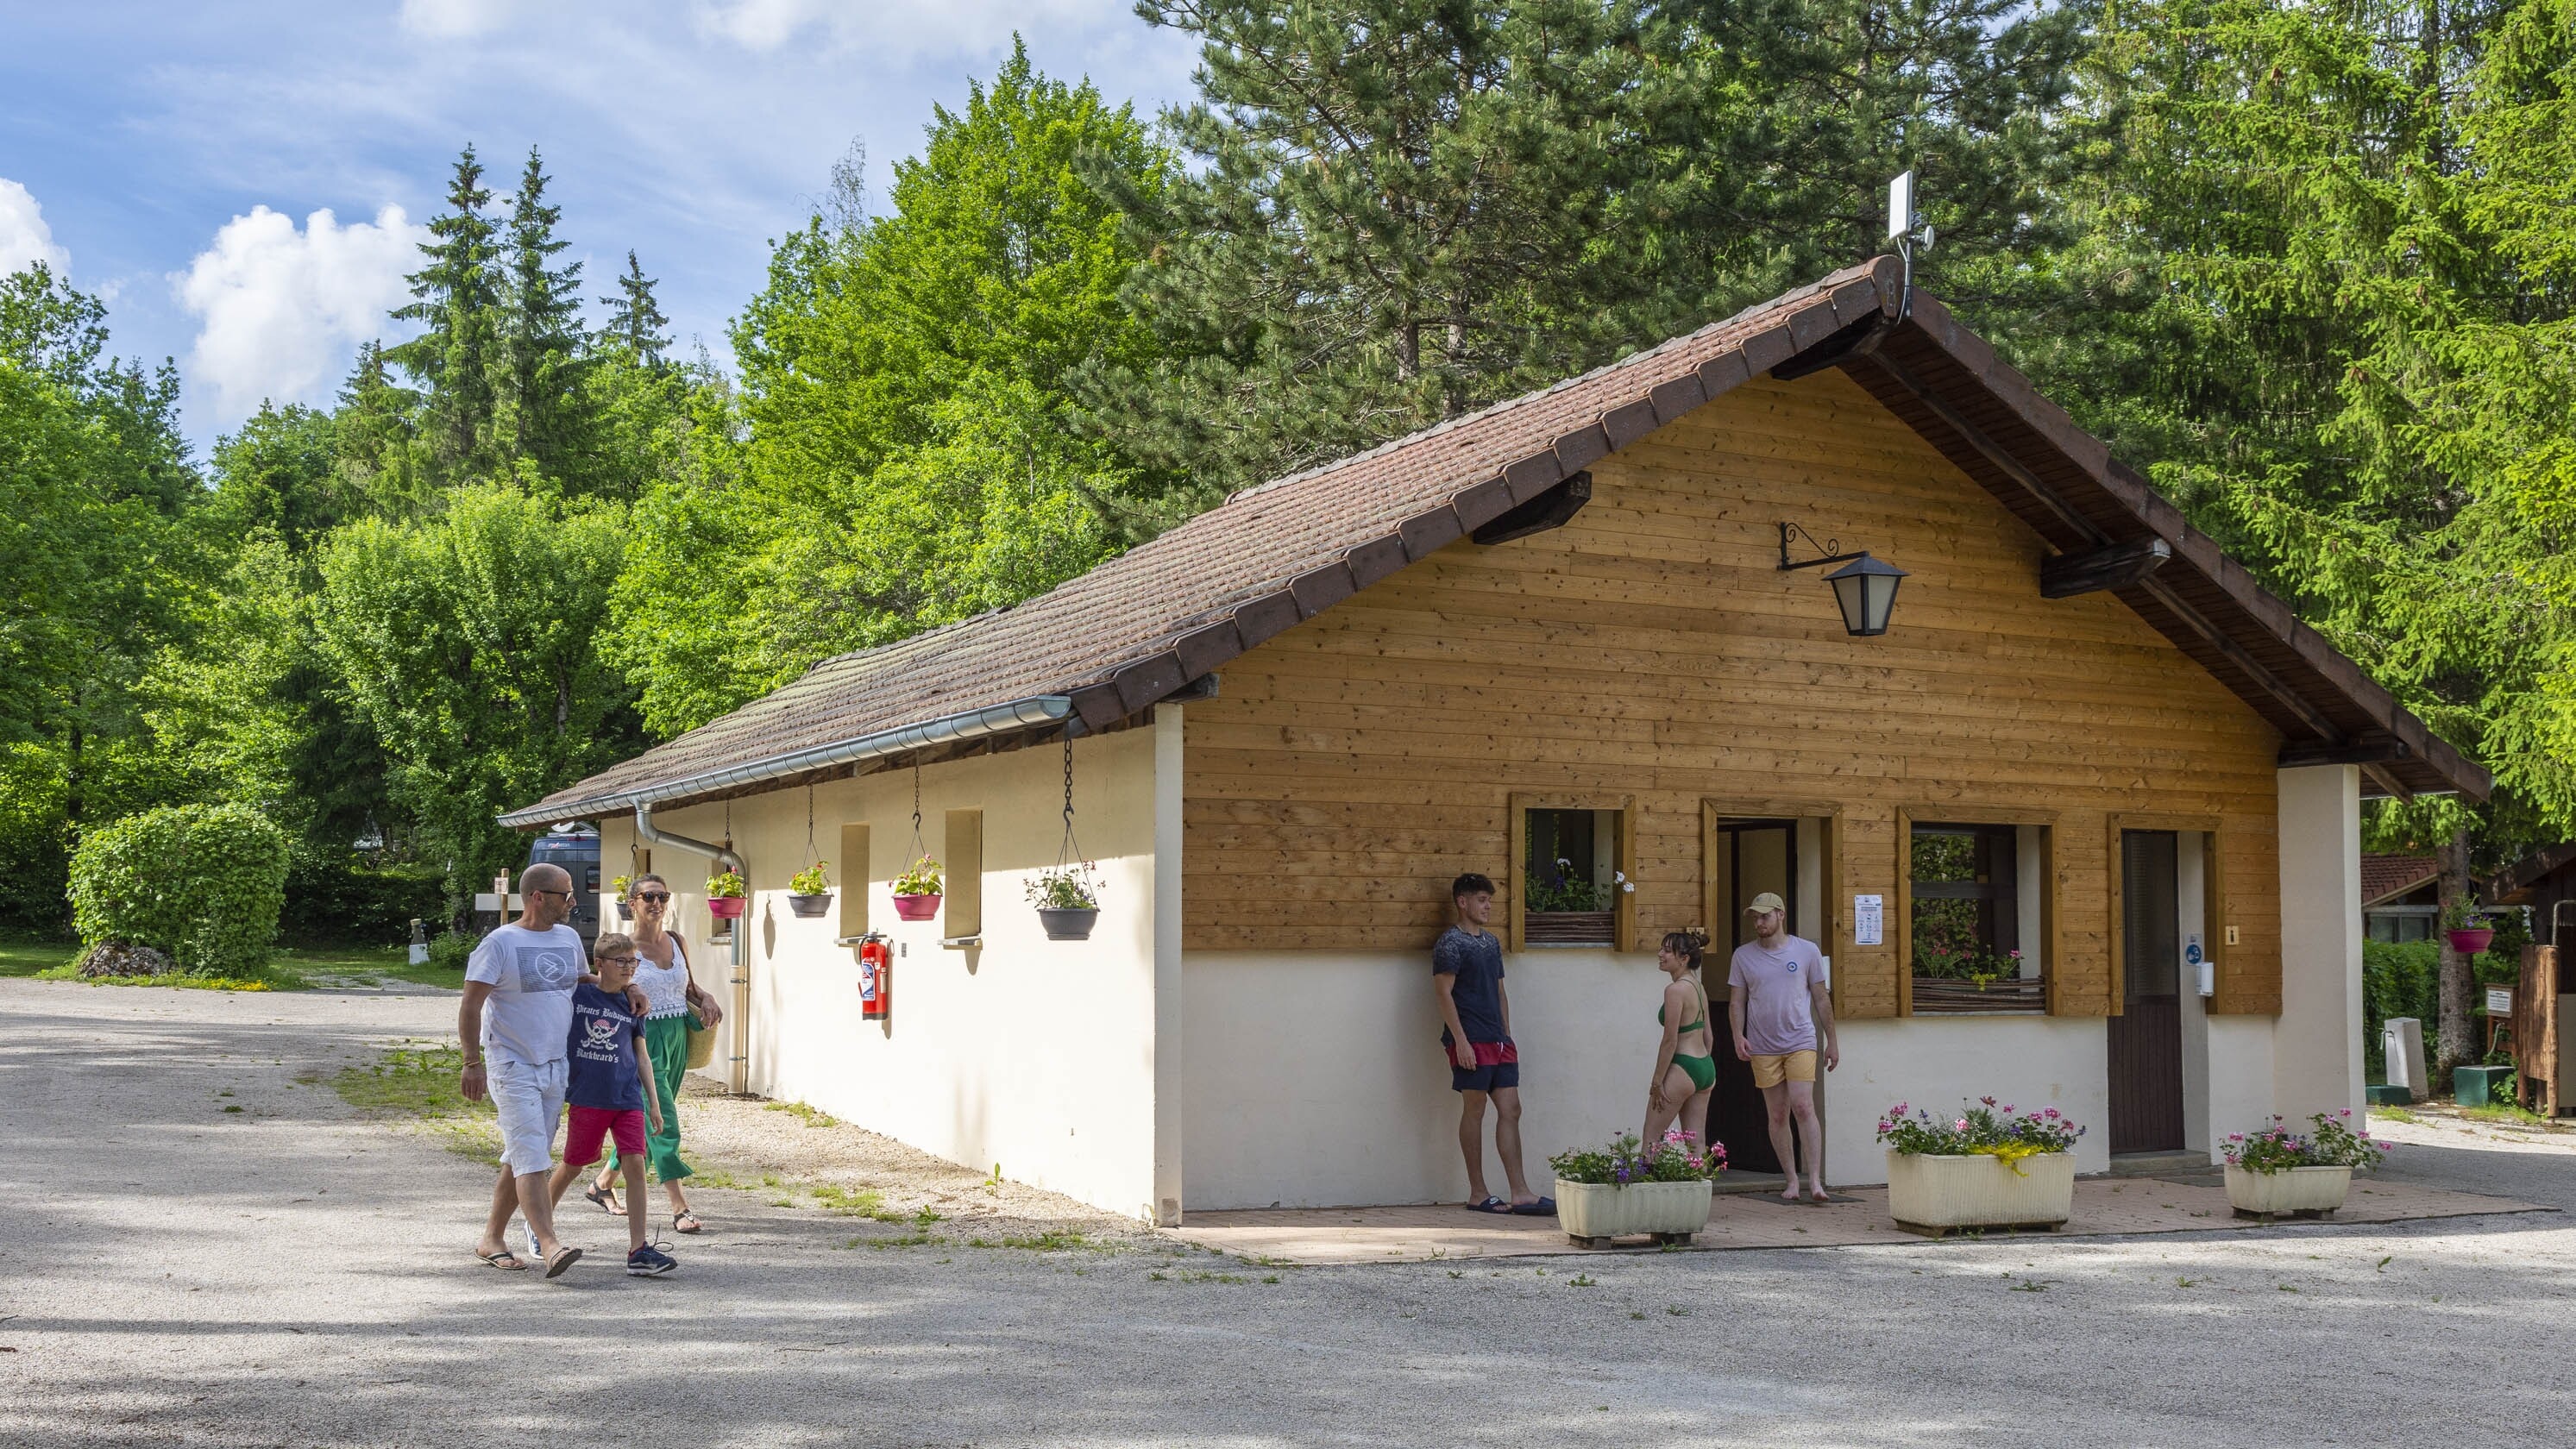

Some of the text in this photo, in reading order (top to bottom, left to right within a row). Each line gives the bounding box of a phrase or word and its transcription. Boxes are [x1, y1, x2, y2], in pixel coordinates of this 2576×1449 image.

[576, 1004, 632, 1023] Pirates Budapest
[576, 1048, 619, 1063] Blackbeard's
